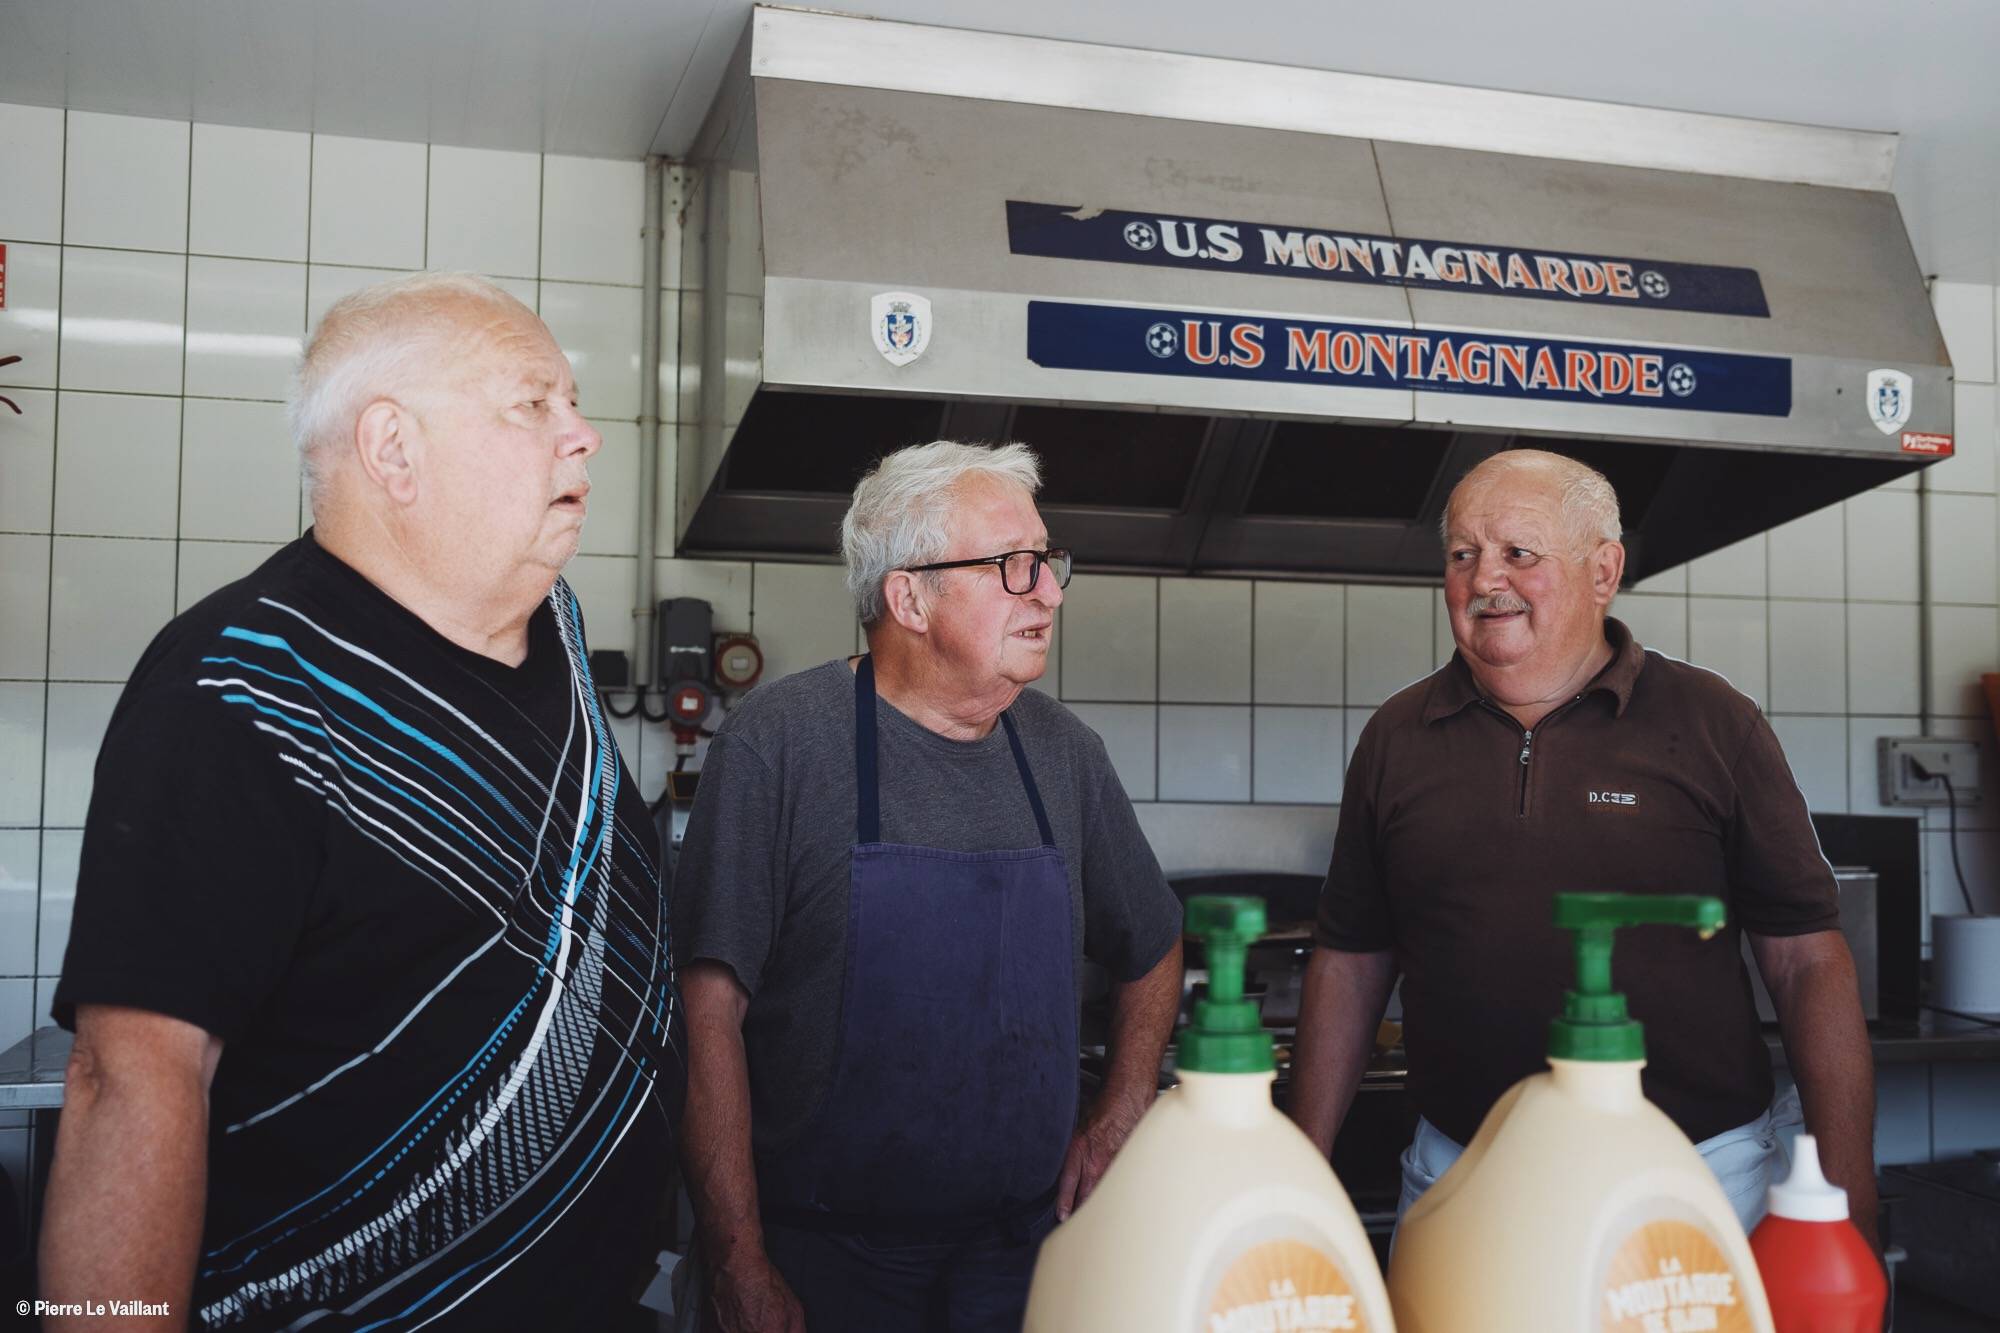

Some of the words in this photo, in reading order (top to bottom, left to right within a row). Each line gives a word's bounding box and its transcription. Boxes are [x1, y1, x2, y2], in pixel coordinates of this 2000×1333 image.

[1158, 219, 1243, 263] U.S
[1259, 228, 1640, 299] MONTAGNARDE
[1182, 319, 1265, 369] U.S
[1285, 326, 1664, 398] MONTAGNARDE
